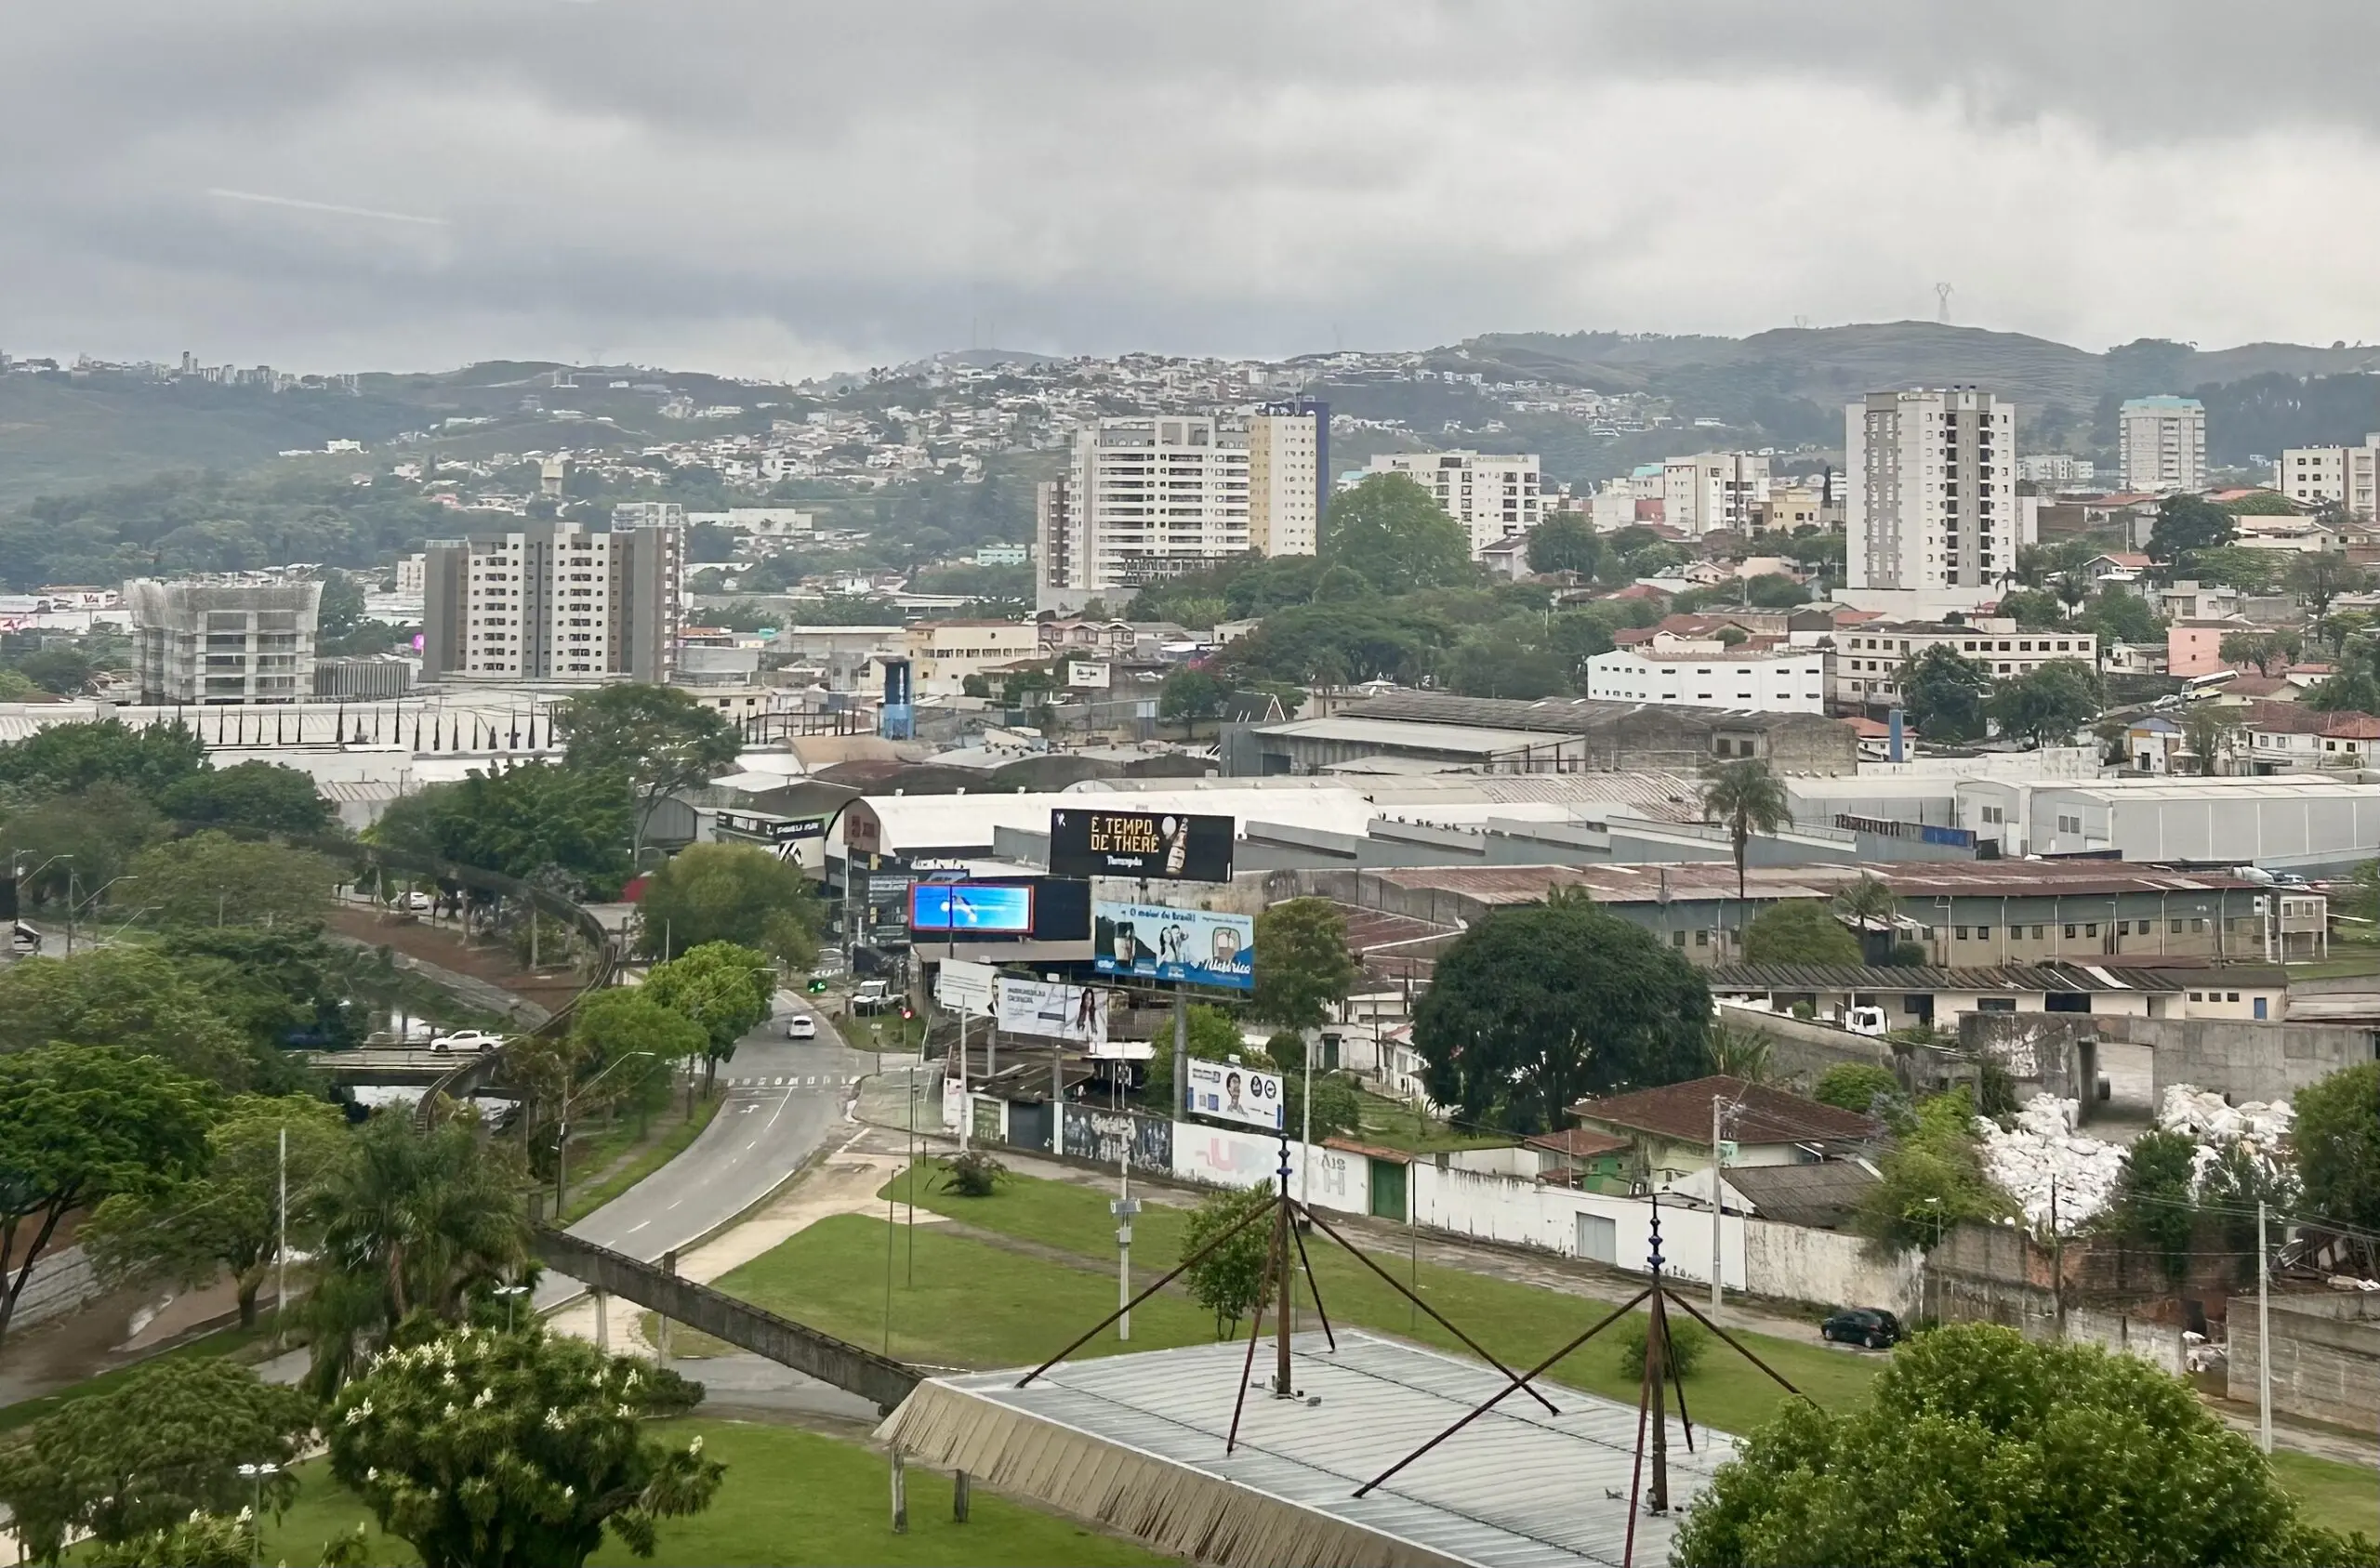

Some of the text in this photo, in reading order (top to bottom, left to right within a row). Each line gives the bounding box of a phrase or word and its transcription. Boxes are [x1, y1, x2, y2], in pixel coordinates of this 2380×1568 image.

[1091, 814, 1153, 836] É TEMPO
[1091, 834, 1160, 853] DE THERÉ
